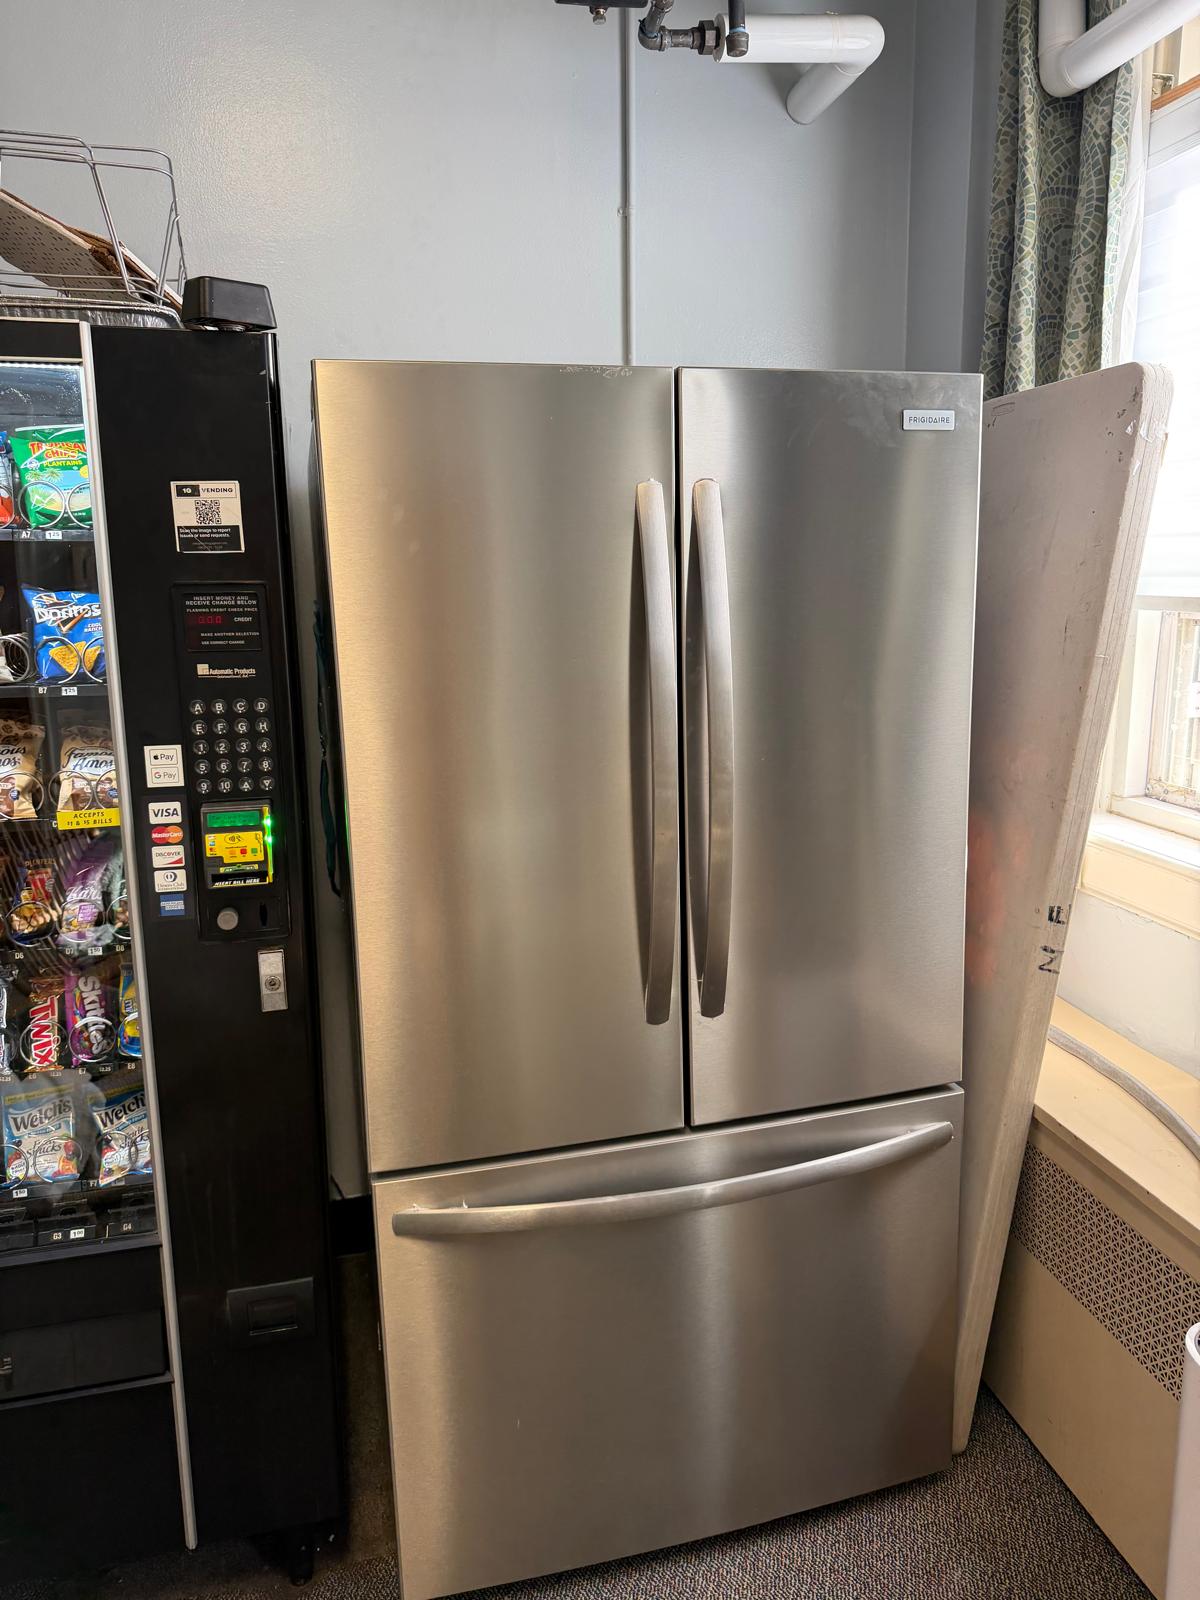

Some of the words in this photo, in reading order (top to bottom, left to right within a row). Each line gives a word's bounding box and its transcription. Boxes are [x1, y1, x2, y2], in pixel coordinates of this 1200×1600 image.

[908, 416, 950, 424] FRIGIDAIRE
[44, 449, 79, 459] CHIPS
[34, 604, 101, 623] Doritos
[160, 753, 174, 761] Pay
[163, 771, 176, 780] Pay
[73, 811, 105, 819] ACCEPTS
[152, 808, 179, 818] VISA
